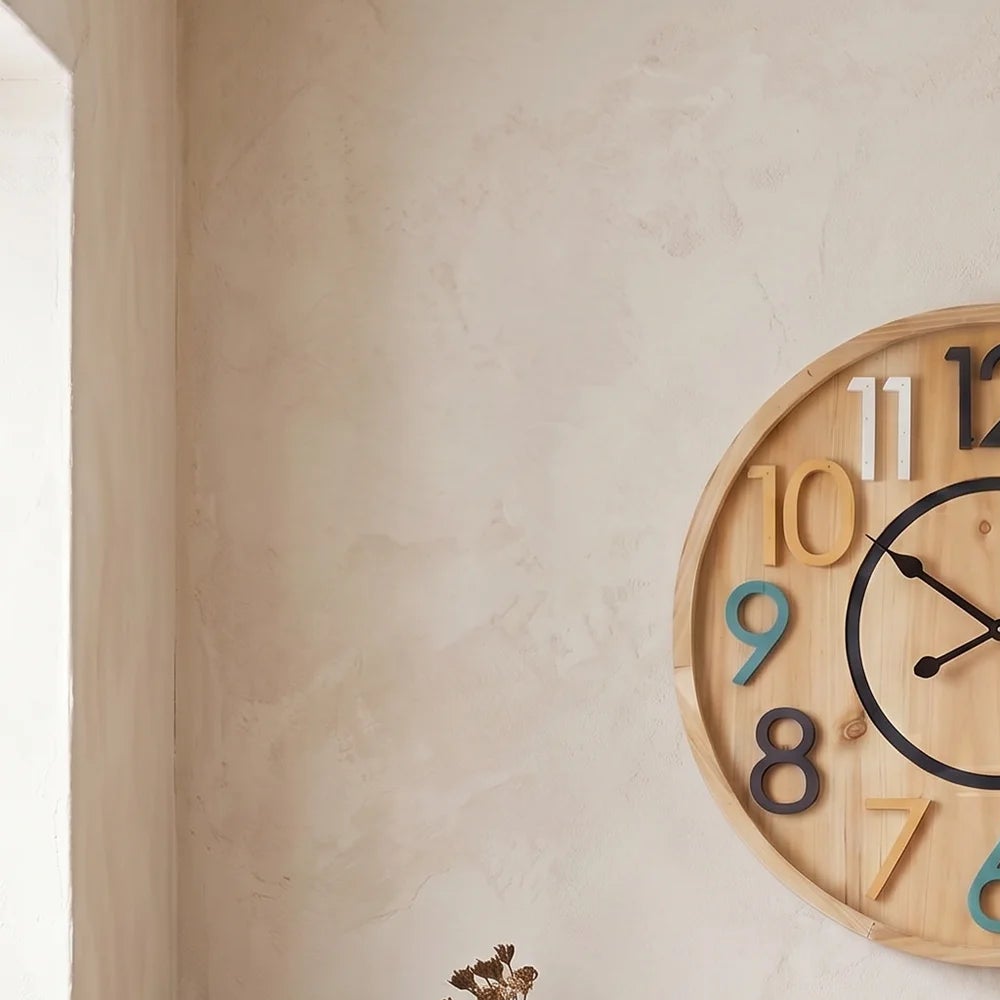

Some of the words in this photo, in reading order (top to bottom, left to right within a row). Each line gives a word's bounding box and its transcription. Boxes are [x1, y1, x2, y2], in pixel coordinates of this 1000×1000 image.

[847, 376, 912, 481] 11
[747, 459, 856, 568] 10
[725, 580, 790, 687] 9
[749, 707, 821, 815] 8
[864, 797, 935, 901] 7
